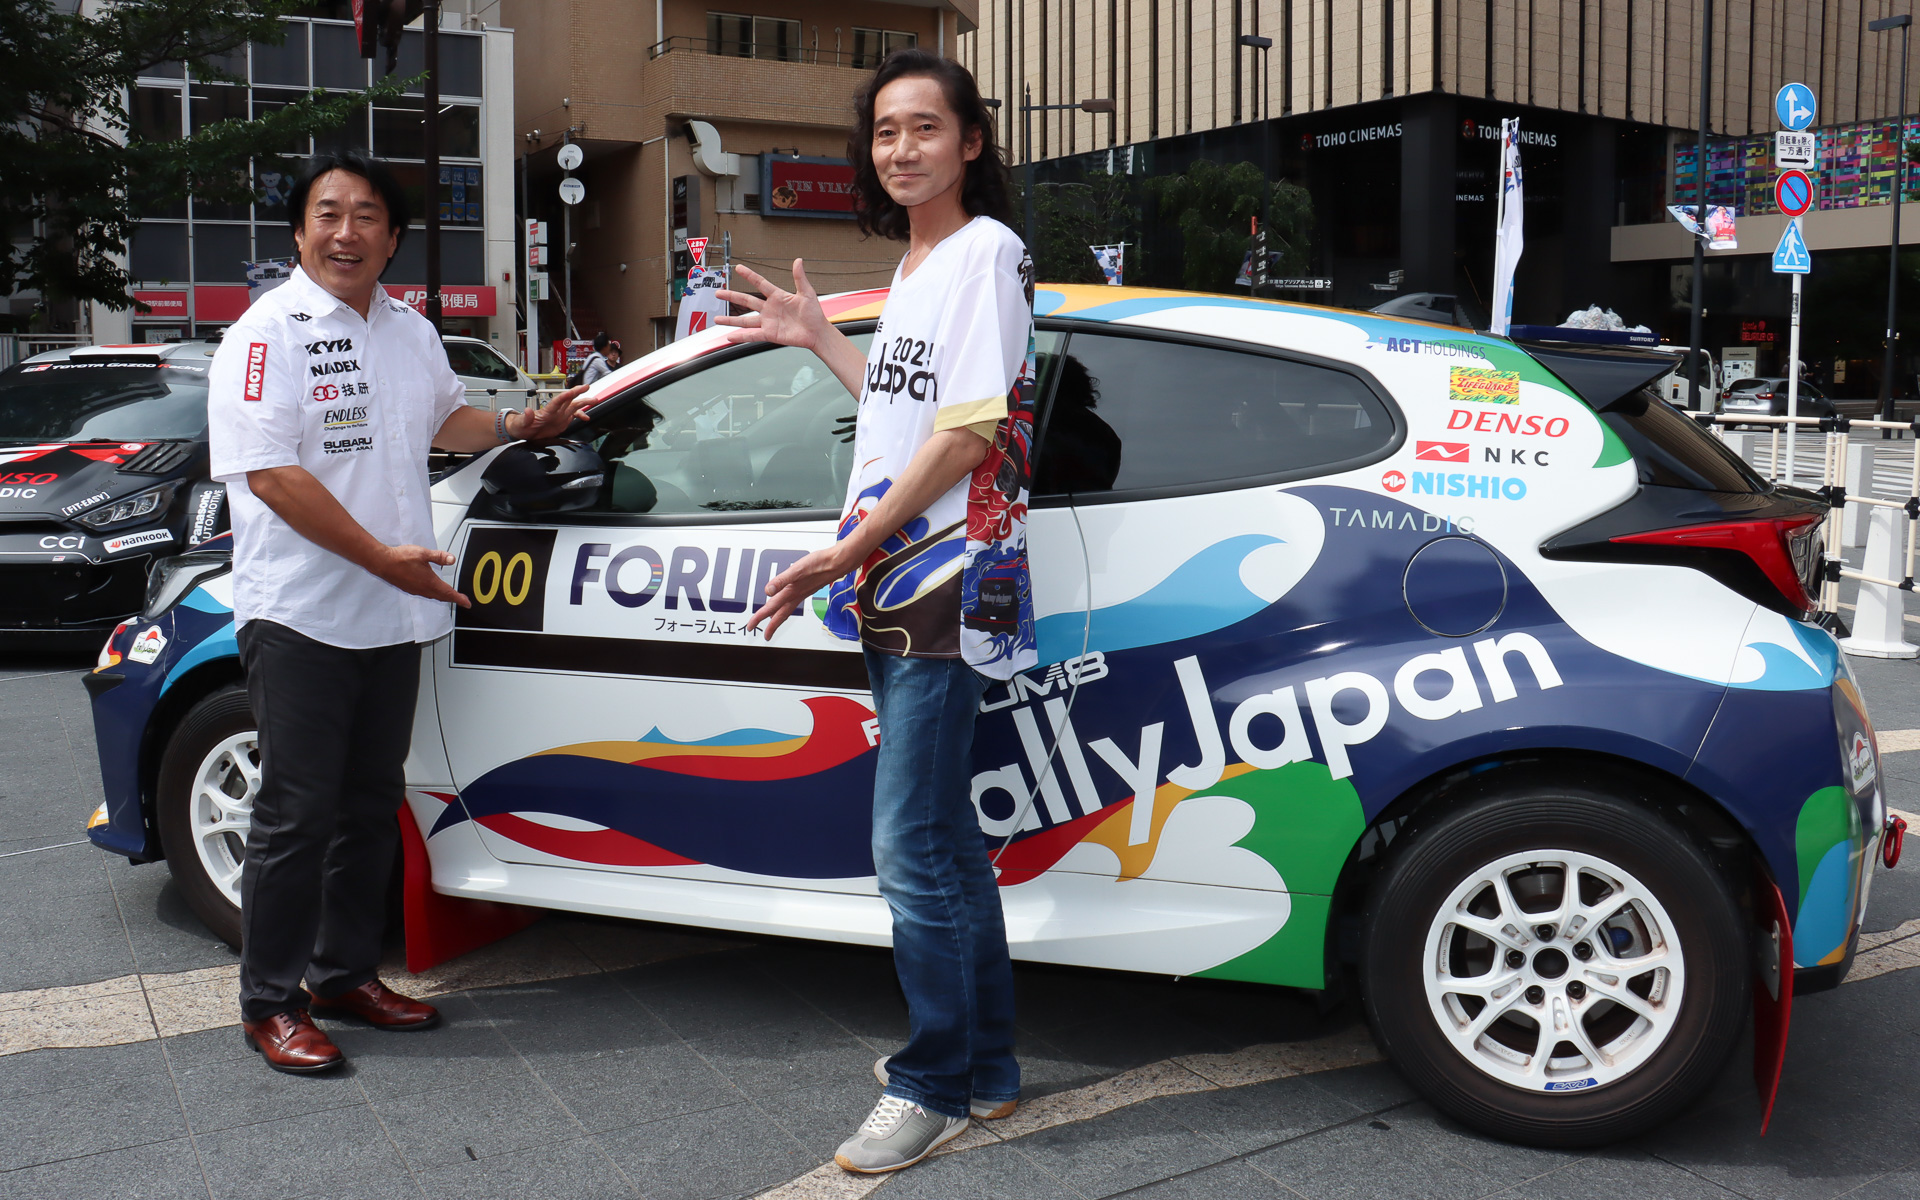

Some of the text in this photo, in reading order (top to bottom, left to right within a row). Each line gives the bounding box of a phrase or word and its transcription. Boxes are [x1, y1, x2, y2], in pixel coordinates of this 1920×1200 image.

[1316, 123, 1402, 148] TOHO CINEMAS
[1478, 125, 1557, 147] TOH INEMAS
[1780, 147, 1810, 157] 一方通行
[1455, 194, 1485, 202] INEMAS
[440, 293, 478, 308] 郵便局
[305, 338, 352, 356] KYB
[1386, 337, 1486, 359] ACT HOLDINGS
[157, 363, 205, 372] Racing
[247, 345, 264, 398] MOTUL
[341, 382, 369, 397] 技研
[1457, 377, 1513, 391] LIFEGUARD
[324, 406, 367, 424] ENDLESS
[1447, 409, 1569, 438] DENSO
[323, 437, 372, 449] SUBARU
[1485, 447, 1549, 467] NKC
[1411, 471, 1527, 501] NISHIO
[189, 490, 213, 545] Panasonic
[203, 489, 224, 540] UTOMOTIVE
[1329, 507, 1475, 535] TAMADIC
[472, 551, 533, 606] 00
[1552, 1079, 1588, 1090] RAYS
